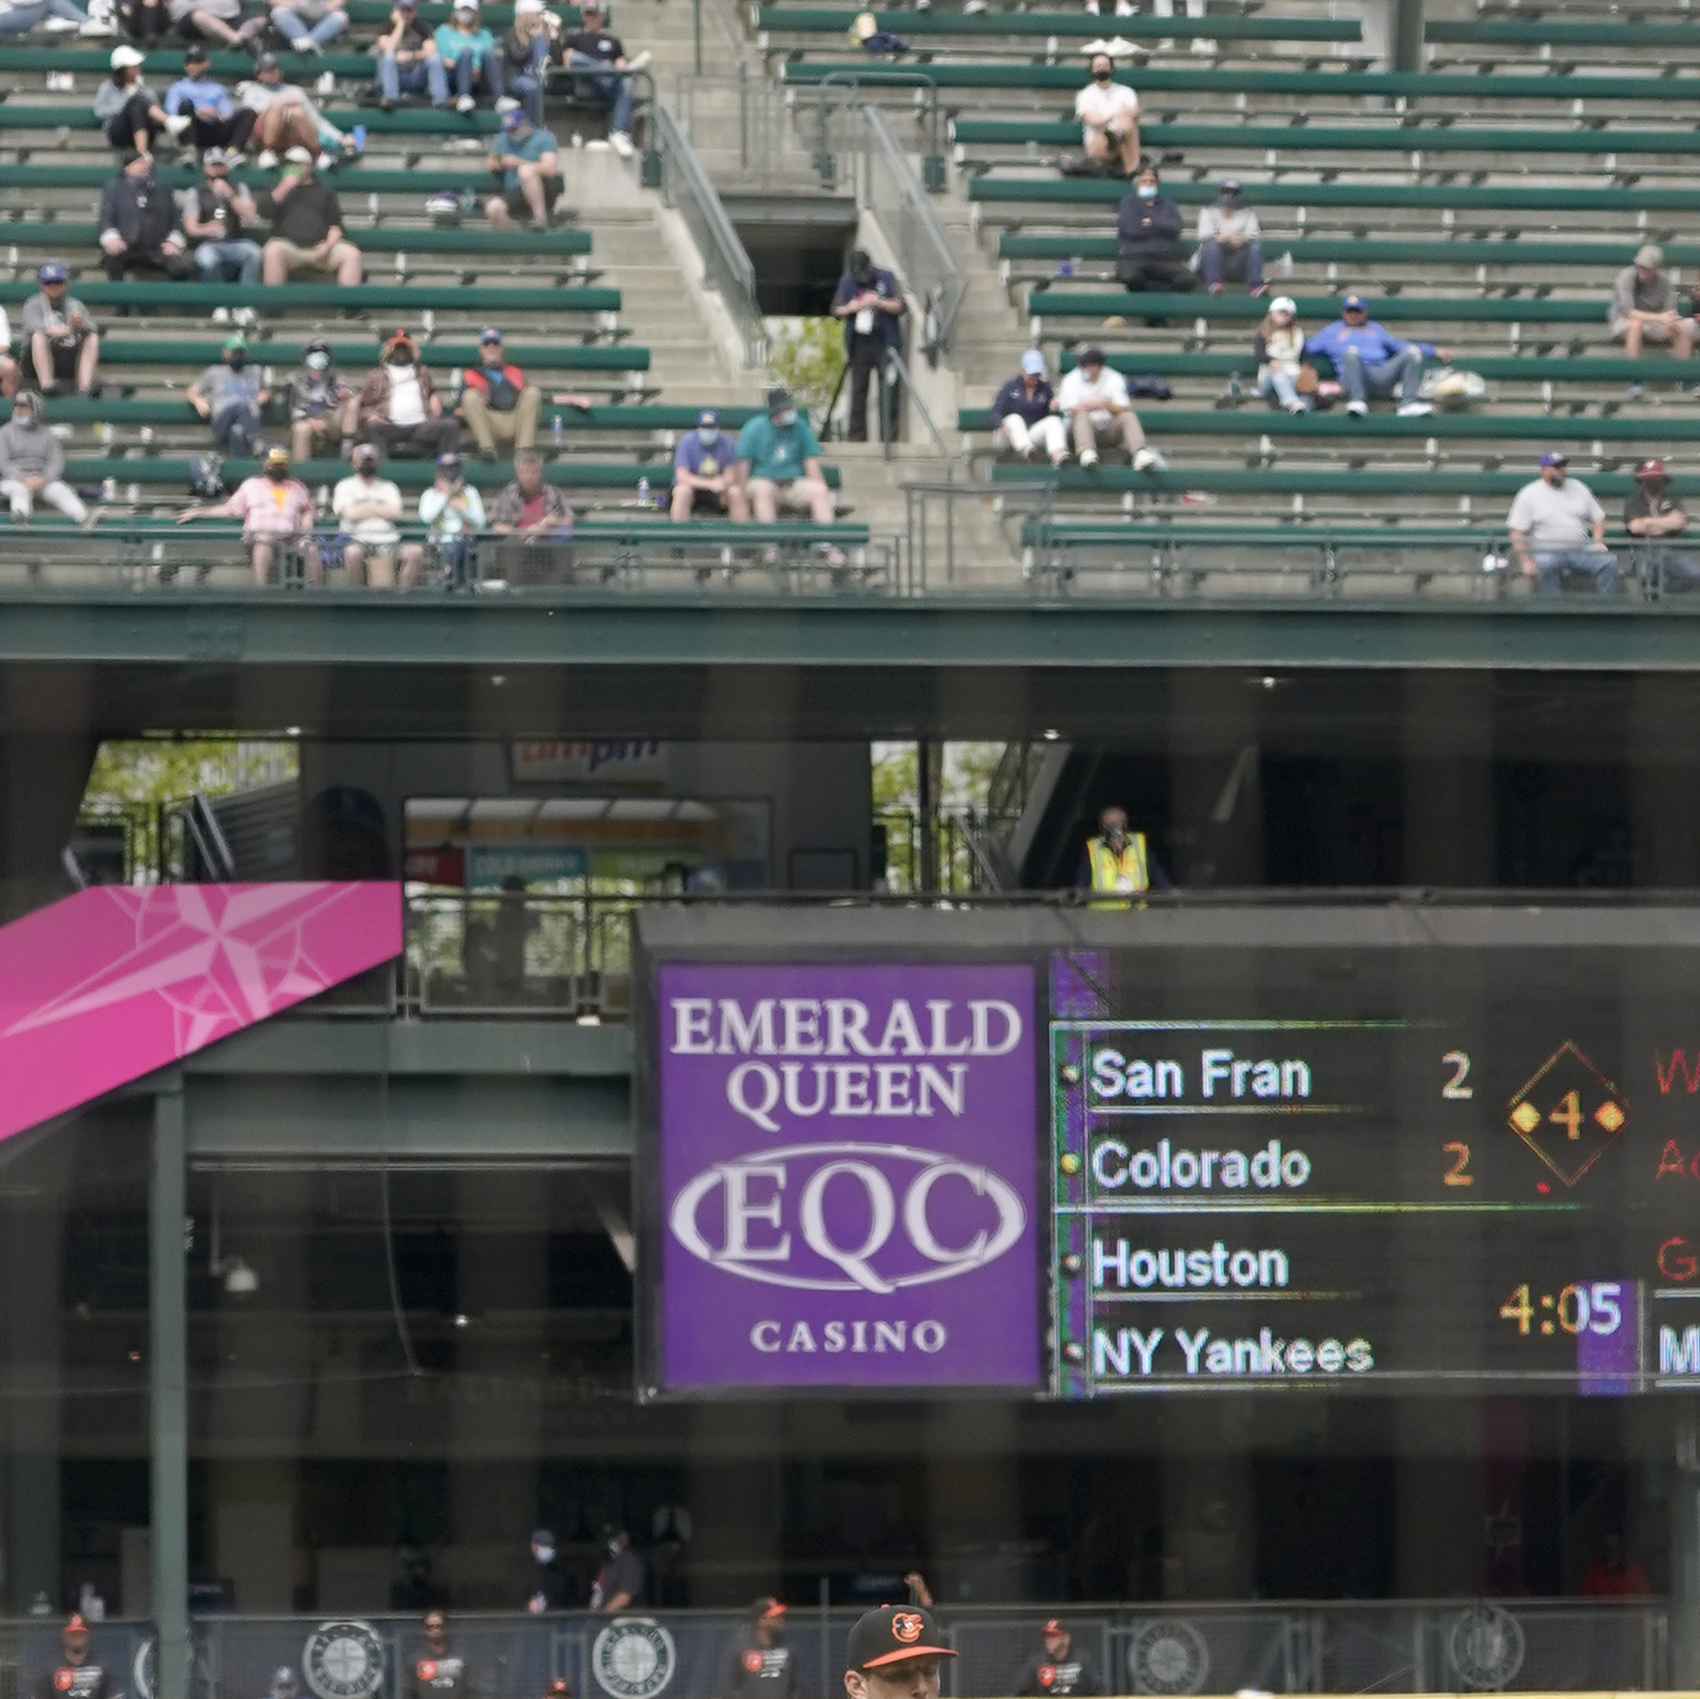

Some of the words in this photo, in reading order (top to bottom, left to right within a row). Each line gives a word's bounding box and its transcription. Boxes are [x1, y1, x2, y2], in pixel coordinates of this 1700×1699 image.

[670, 998, 1023, 1057] EMERALD
[726, 1060, 970, 1132] QUEEN
[1091, 1048, 1184, 1098] San
[1202, 1048, 1311, 1098] Fran
[1441, 1050, 1473, 1099] 2
[1549, 1089, 1584, 1141] 4
[1092, 1138, 1312, 1189] Colorado
[1442, 1142, 1474, 1186] 2
[709, 1158, 990, 1294] EQC
[1092, 1239, 1290, 1288] Houston
[1500, 1282, 1622, 1336] 4:05
[749, 1320, 948, 1353] CASINO
[1092, 1326, 1163, 1375] NY
[1175, 1326, 1375, 1374] Yankees
